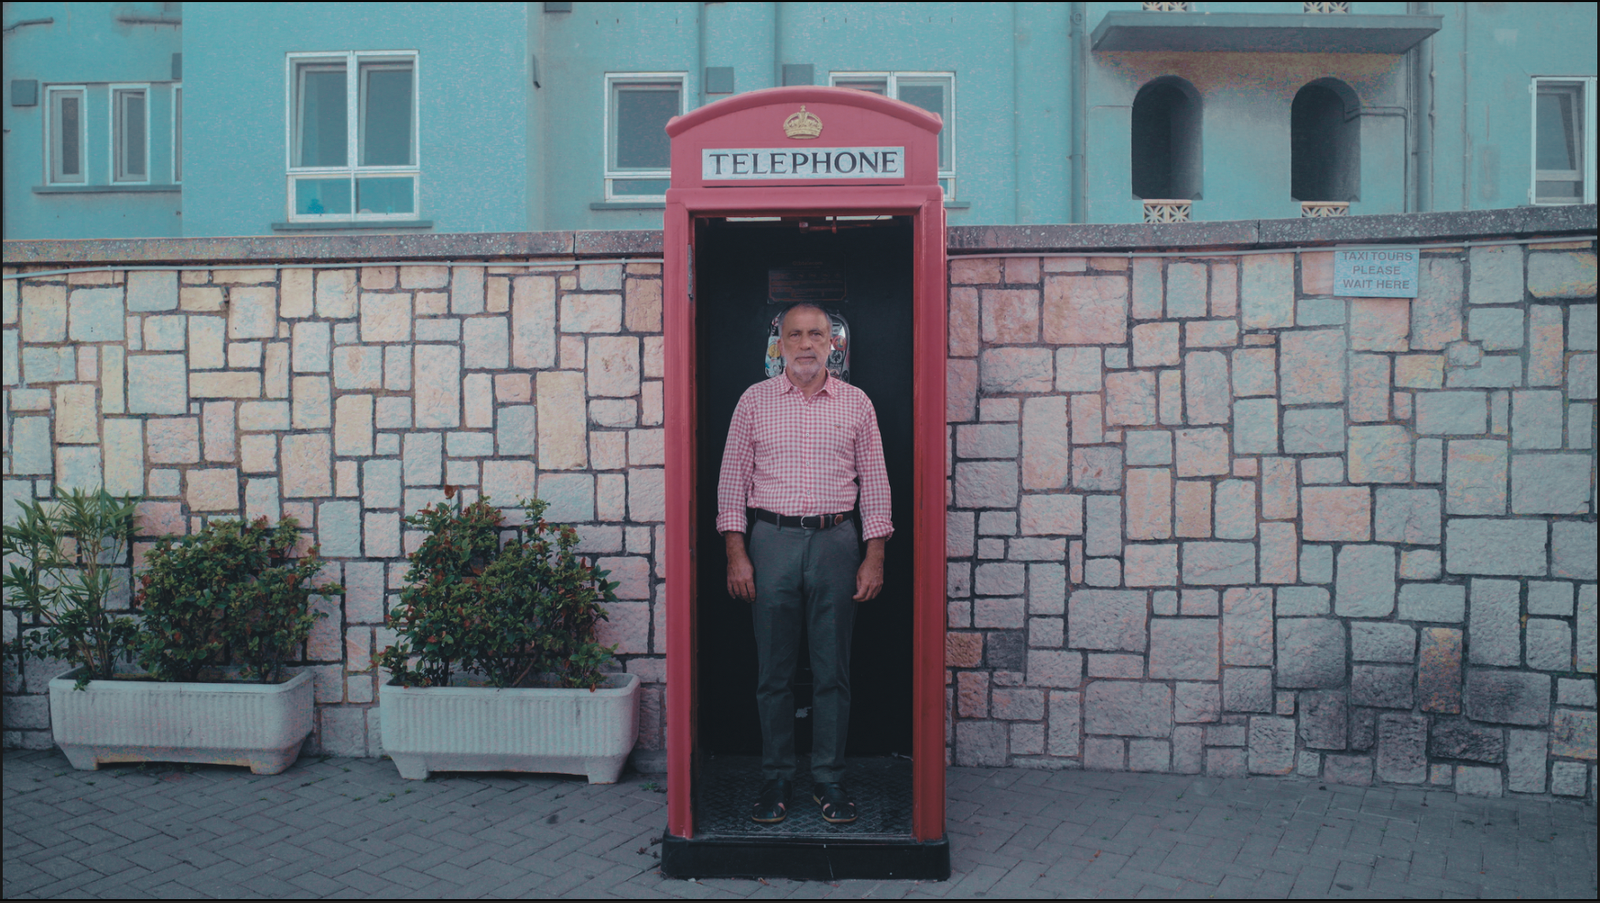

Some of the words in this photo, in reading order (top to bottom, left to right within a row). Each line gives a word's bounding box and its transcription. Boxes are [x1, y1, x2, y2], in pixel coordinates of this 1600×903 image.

[709, 151, 898, 175] TELEPHONE
[1342, 251, 1369, 261] TAXI
[1370, 251, 1413, 261] TOURS
[1352, 265, 1401, 275] PLEASE
[1342, 279, 1373, 289] WAIT
[1376, 280, 1410, 290] HERE
